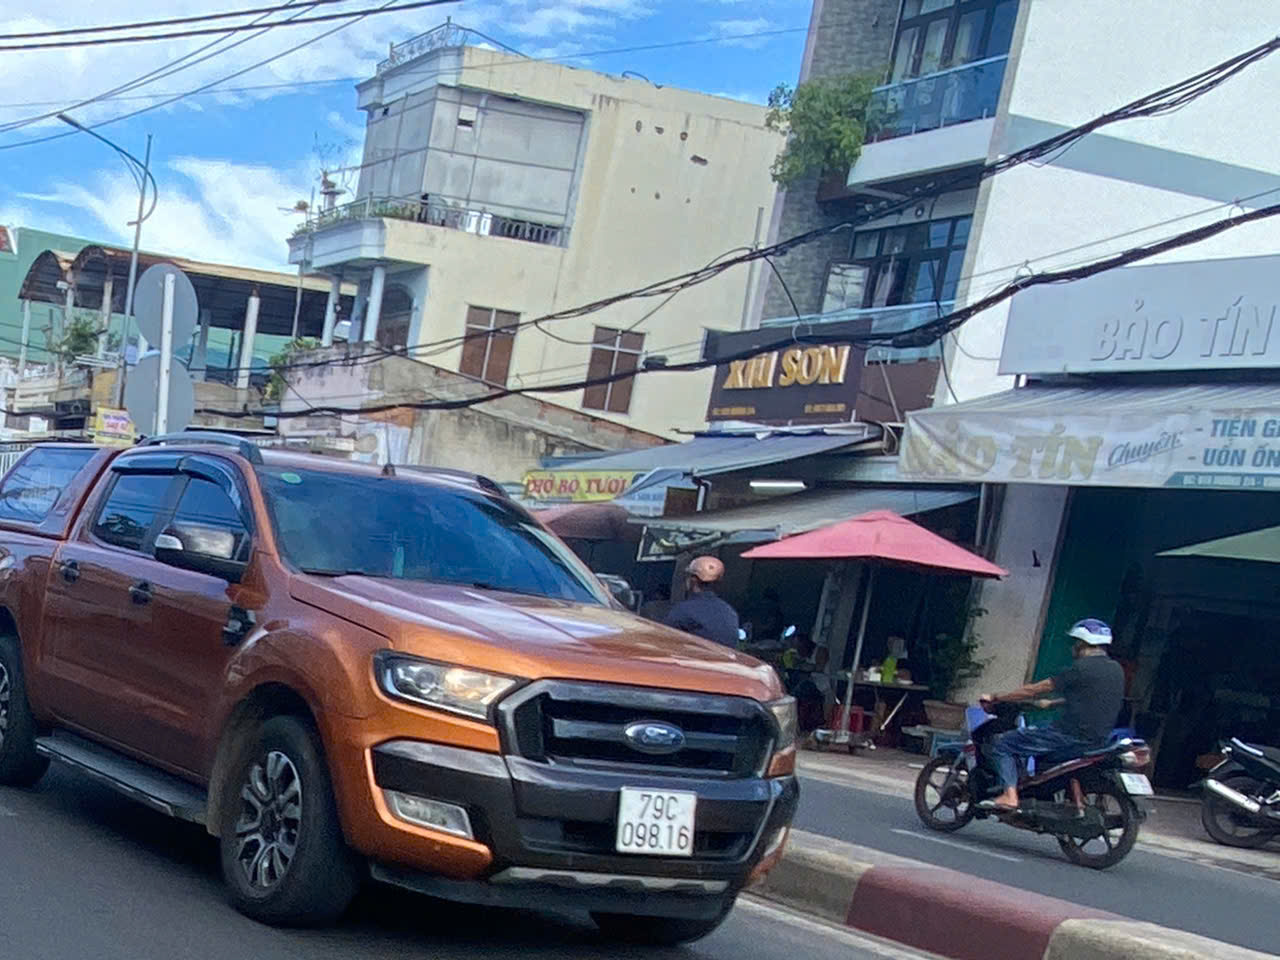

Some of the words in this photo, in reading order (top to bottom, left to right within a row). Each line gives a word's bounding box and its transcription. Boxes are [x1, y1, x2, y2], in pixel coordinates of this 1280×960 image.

[1090, 299, 1184, 361] BẢO
[1200, 295, 1276, 358] TÍN
[1010, 423, 1104, 479] TÍN
[639, 793, 678, 821] 79C
[621, 821, 689, 850] 098.16
